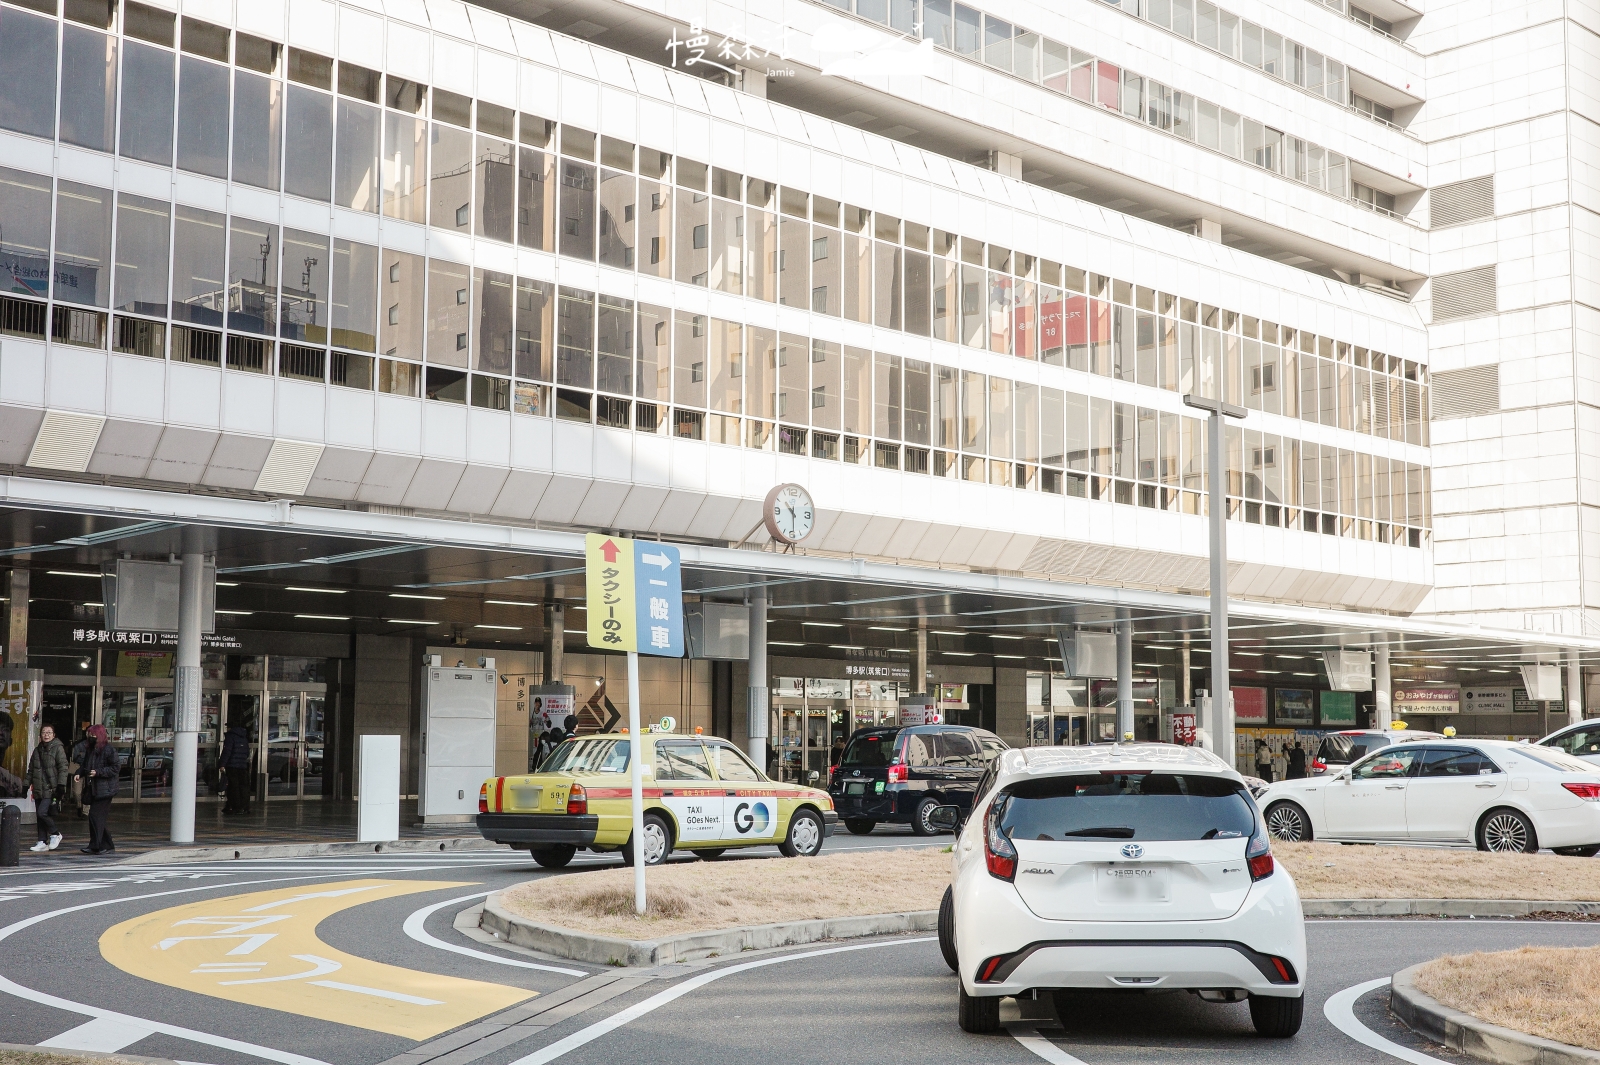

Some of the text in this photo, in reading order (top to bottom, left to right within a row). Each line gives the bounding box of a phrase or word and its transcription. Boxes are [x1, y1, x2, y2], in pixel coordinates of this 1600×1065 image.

[786, 488, 798, 497] 12
[803, 511, 811, 520] 3
[601, 567, 623, 644] タクシーのみ
[649, 578, 671, 649] 一般車
[72, 628, 158, 645] 博多駅(筑紫口)
[516, 677, 526, 711] 博多駅
[686, 806, 703, 814] TAXI
[686, 816, 721, 824] GOes Next.
[1021, 867, 1055, 875] AQUA
